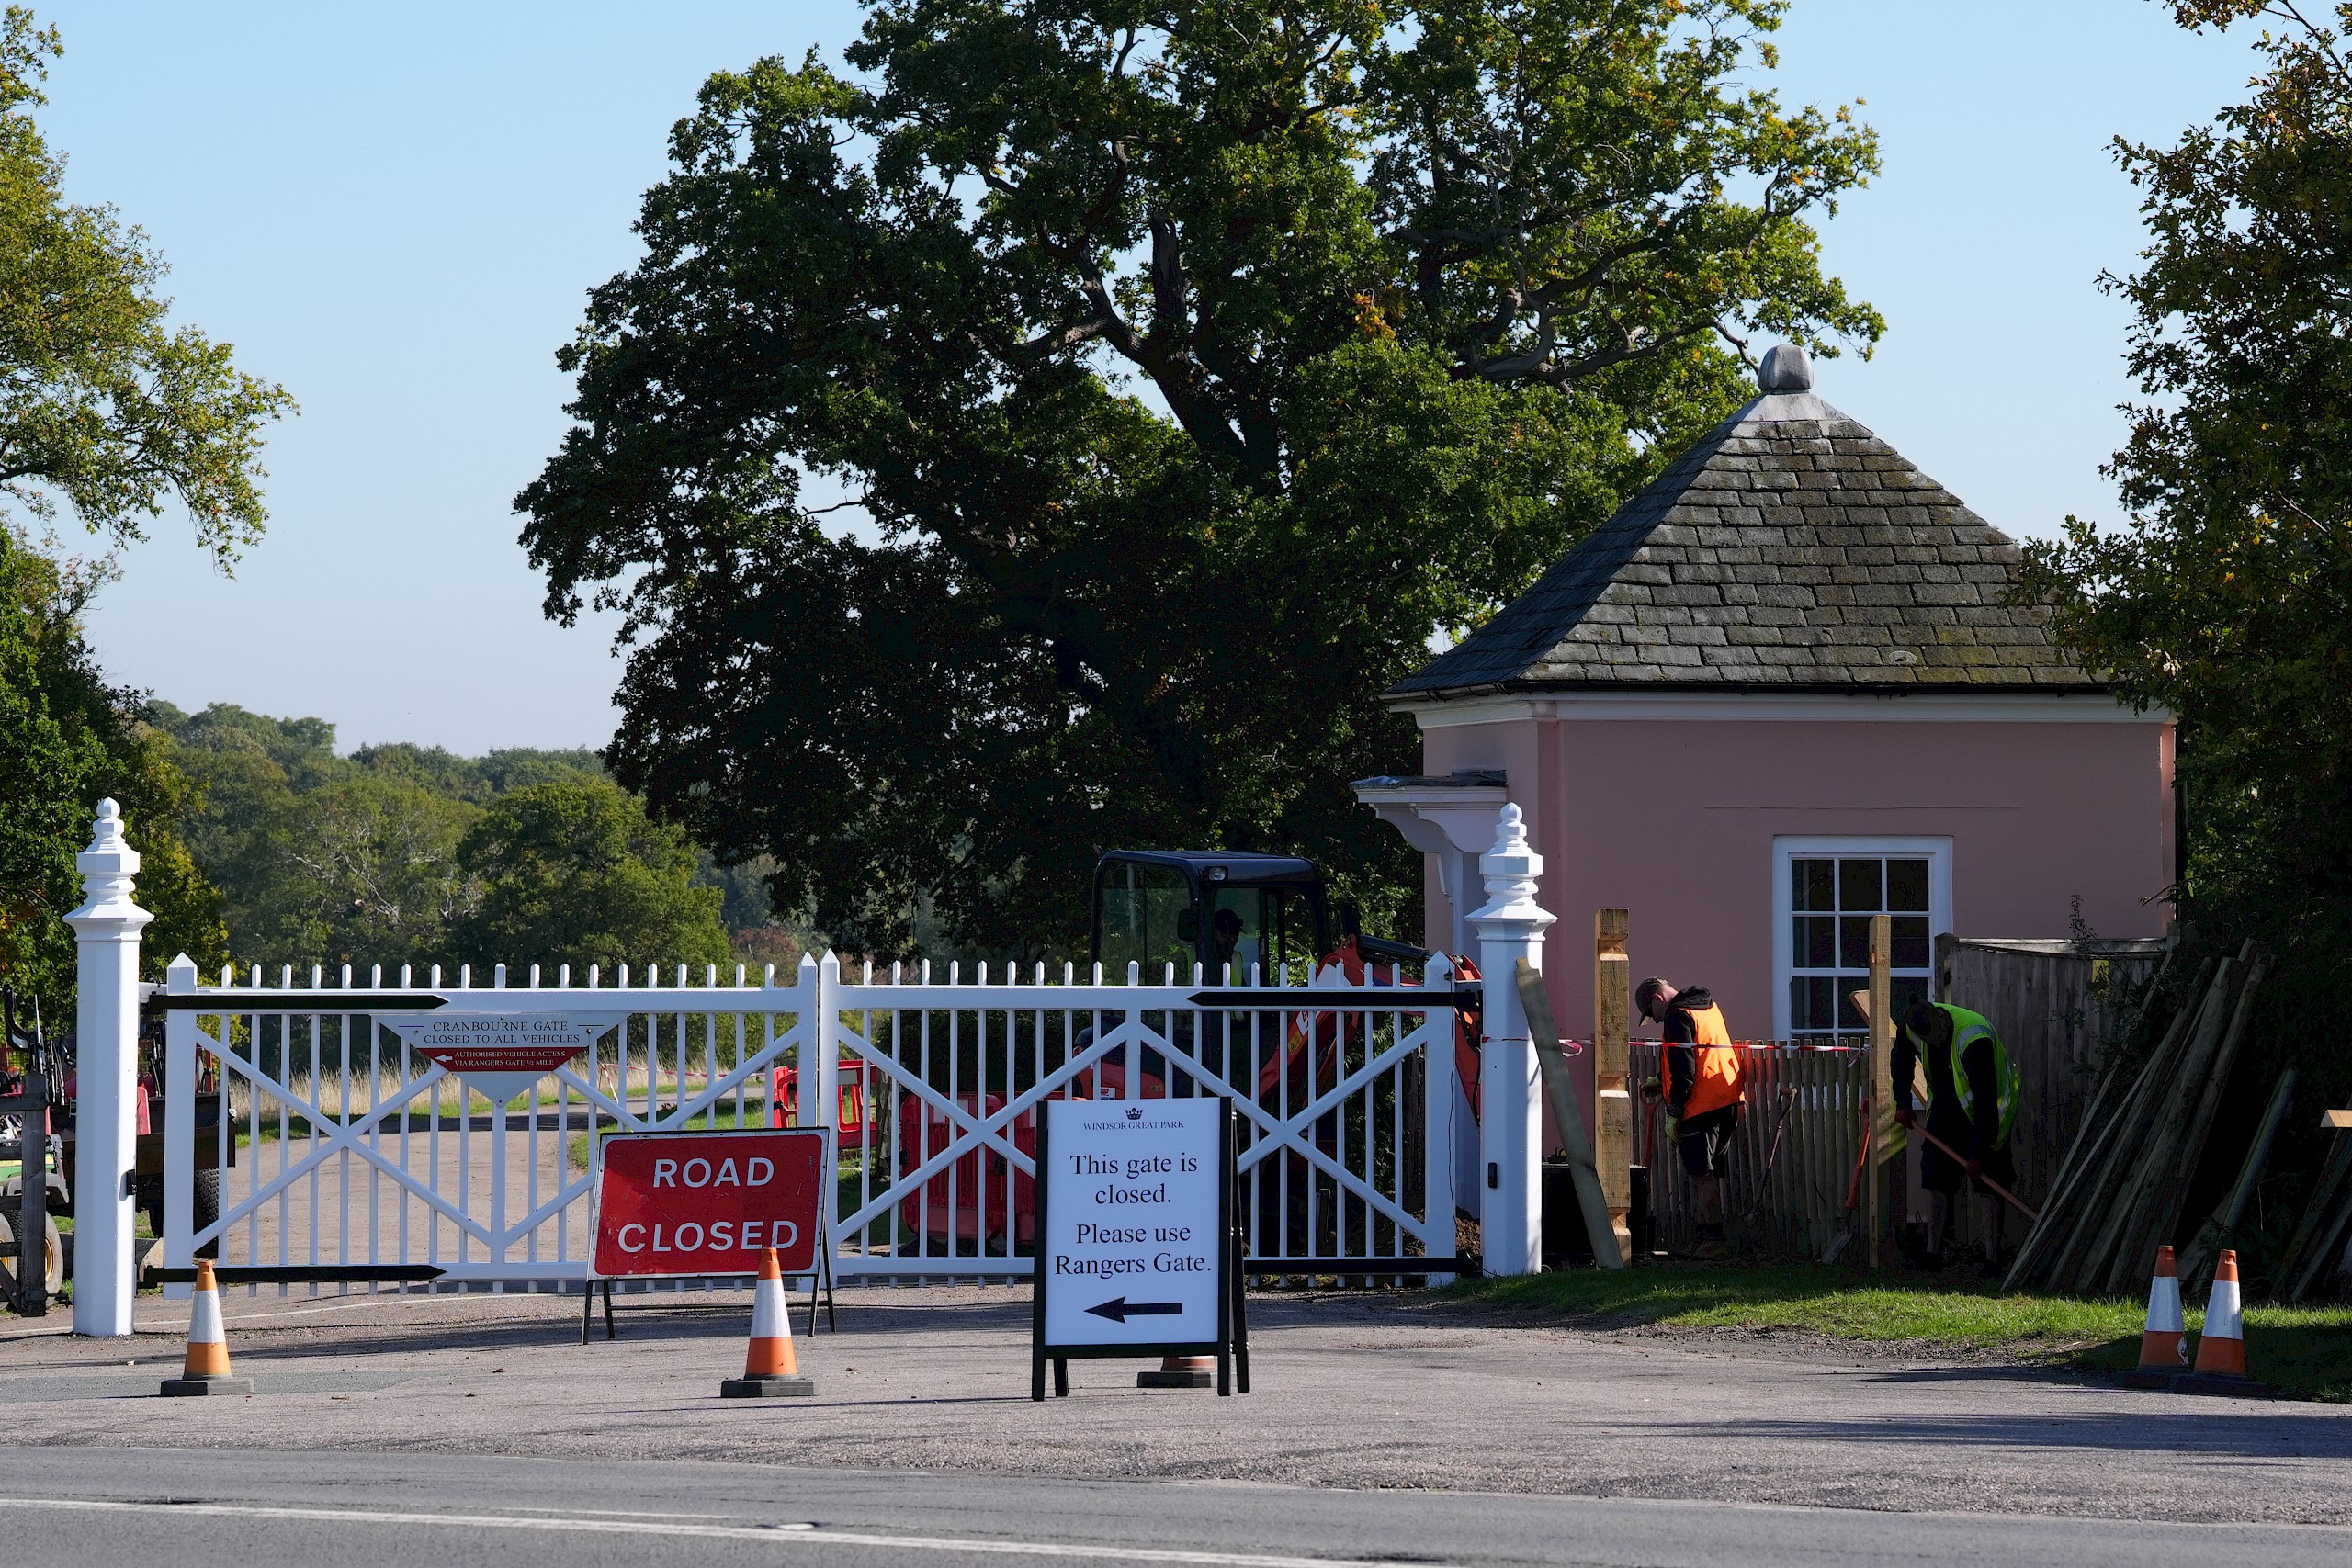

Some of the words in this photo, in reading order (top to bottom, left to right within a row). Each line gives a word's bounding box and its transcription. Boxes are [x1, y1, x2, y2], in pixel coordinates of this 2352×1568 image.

[424, 1034, 470, 1043] CLOSED
[474, 1034, 490, 1043] TO
[494, 1034, 517, 1043] ALL
[522, 1033, 580, 1043] VEHICLES
[433, 1021, 528, 1032] CRANBOURNE
[533, 1021, 568, 1032] GATE
[1083, 1122, 1126, 1131] WINDSOR
[1128, 1121, 1159, 1130] GREAT
[1160, 1120, 1185, 1129] PARK
[652, 1156, 775, 1188] ROAD
[1069, 1154, 1119, 1175] This
[1126, 1155, 1172, 1179] gate
[1181, 1152, 1198, 1172] is
[1094, 1182, 1172, 1205] closed.
[617, 1220, 798, 1253] CLOSED
[1076, 1223, 1147, 1244] Please
[1154, 1226, 1192, 1242] use
[1055, 1254, 1146, 1280] Rangers
[1153, 1252, 1213, 1273] Gate.
